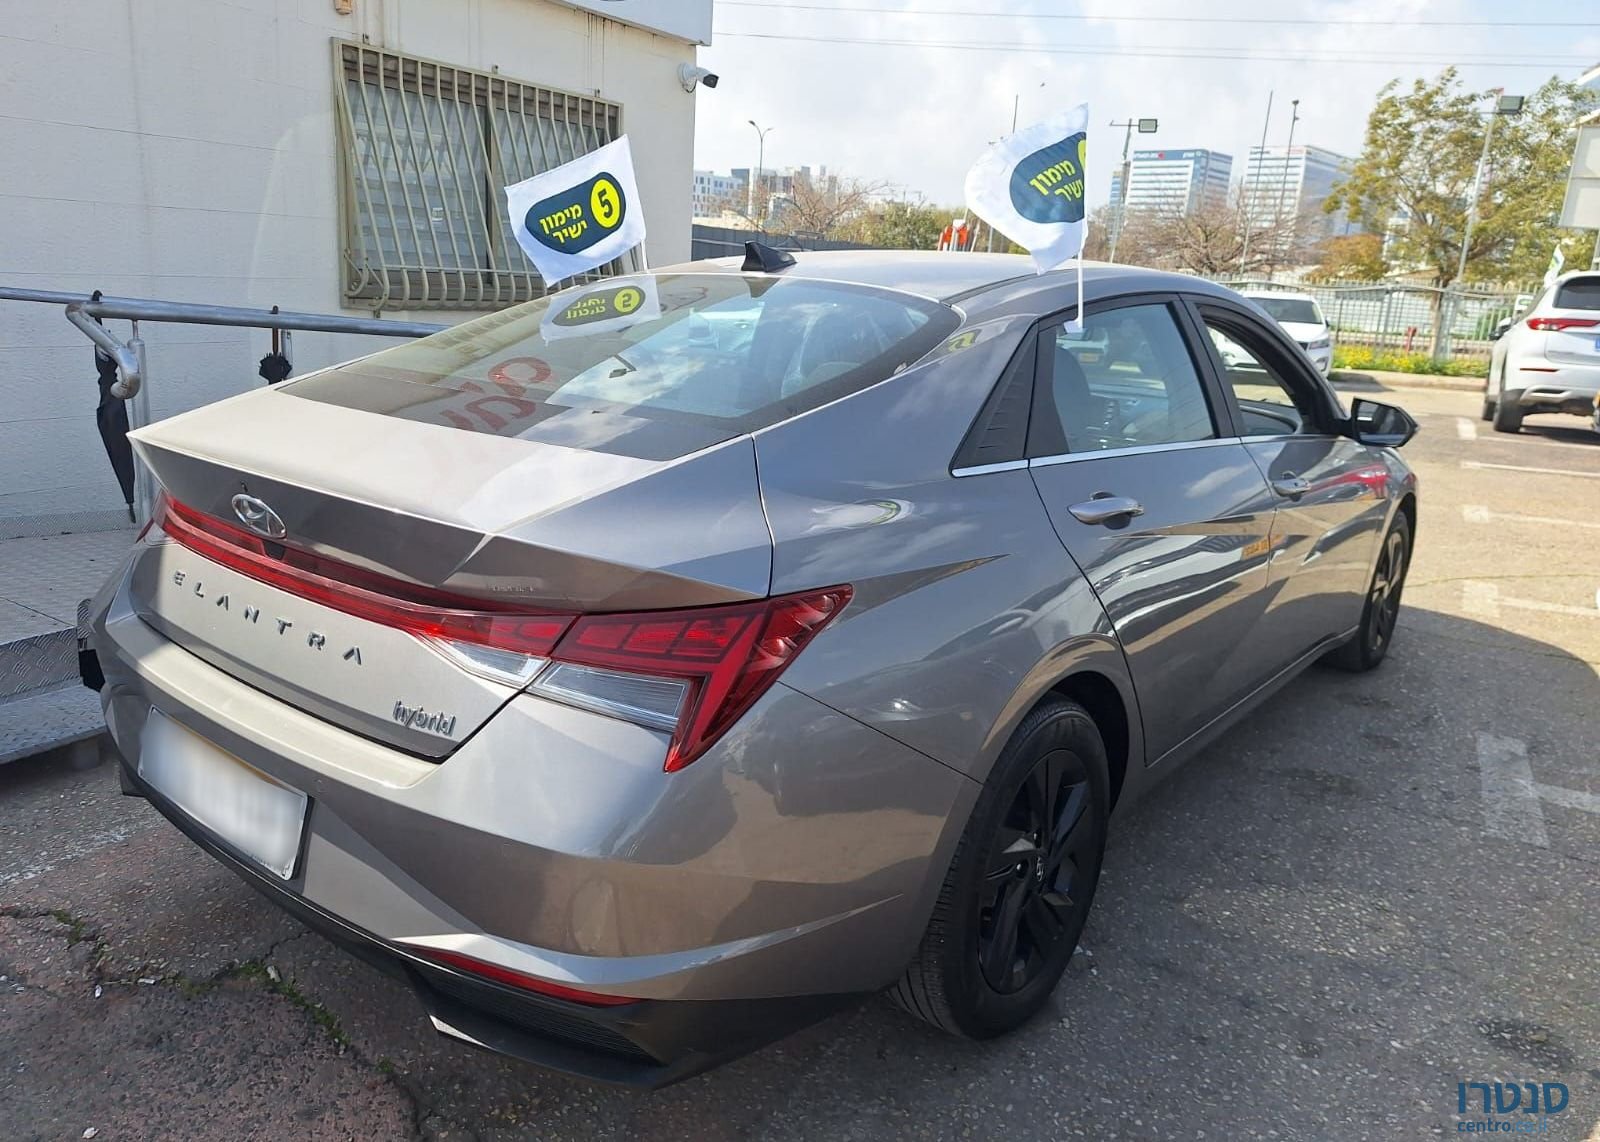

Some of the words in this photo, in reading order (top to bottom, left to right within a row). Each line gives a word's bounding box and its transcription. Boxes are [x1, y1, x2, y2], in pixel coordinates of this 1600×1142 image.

[1030, 160, 1075, 195] מימון
[540, 203, 582, 234] מימון
[598, 189, 614, 218] 5
[552, 220, 587, 243] ישיר
[173, 572, 362, 665] ELANTRA
[393, 701, 456, 736] hybrid
